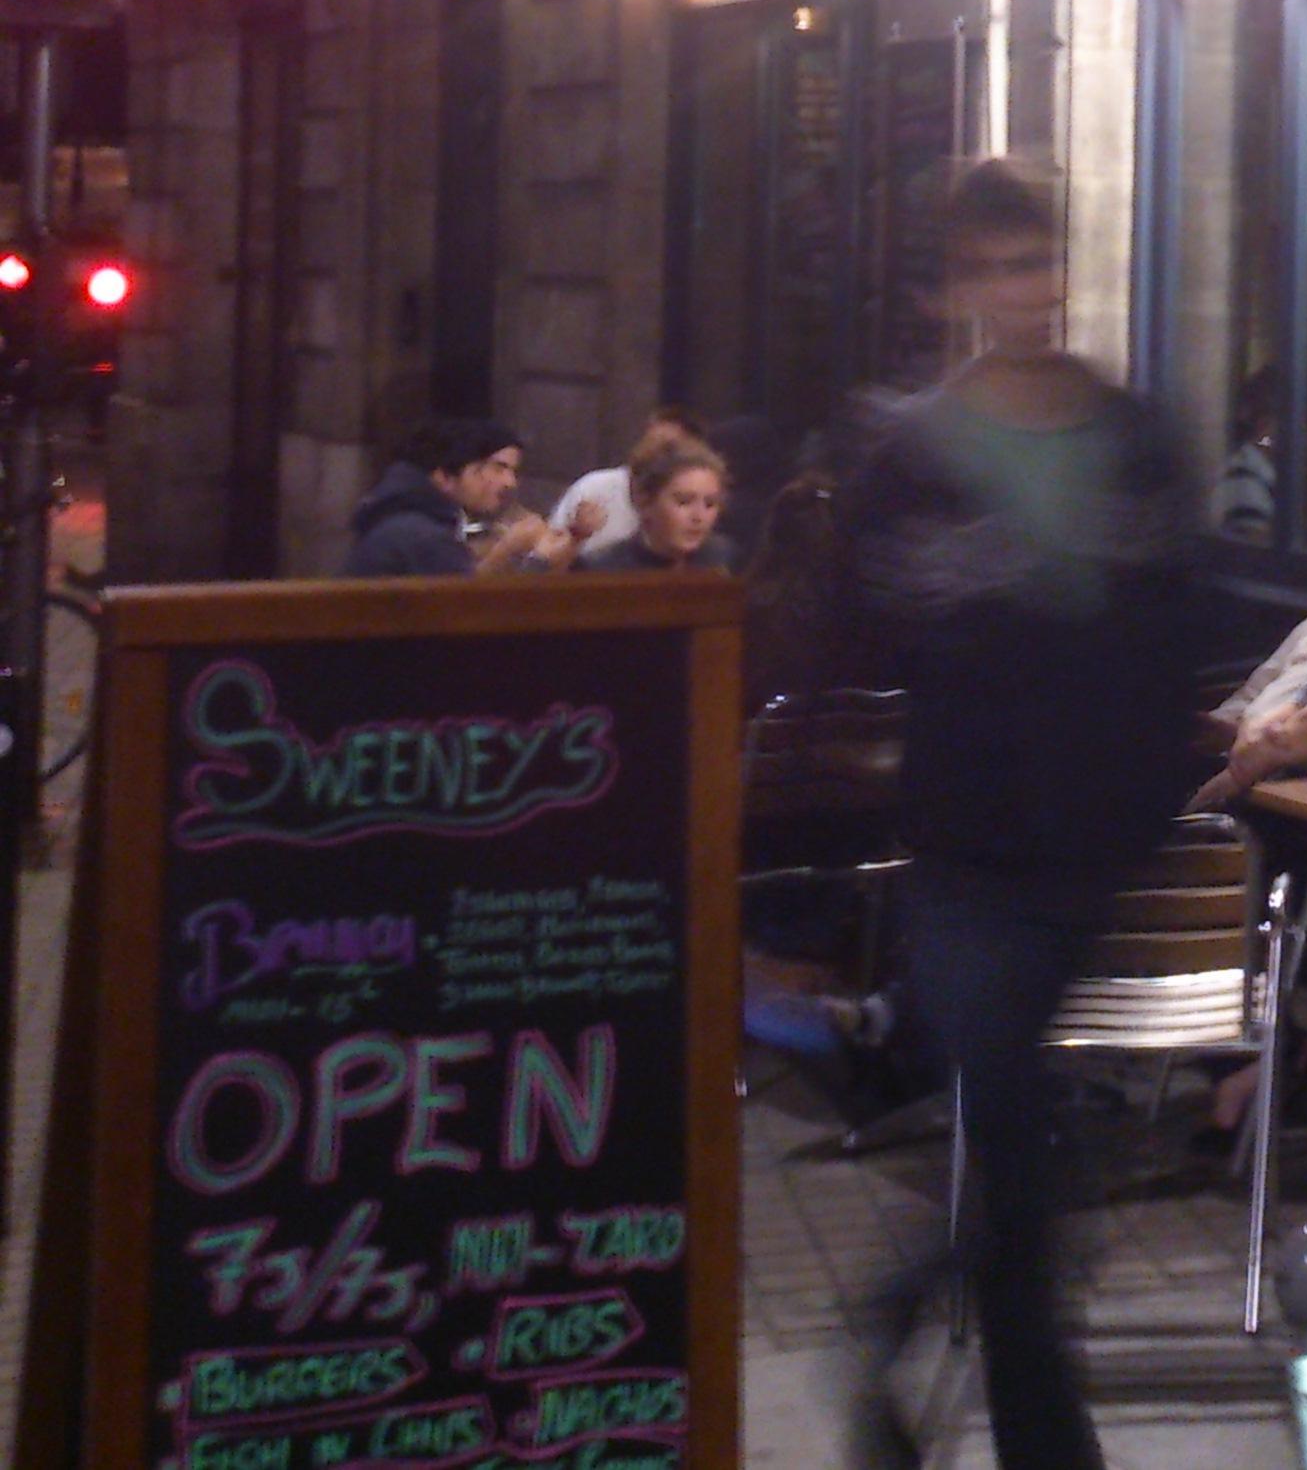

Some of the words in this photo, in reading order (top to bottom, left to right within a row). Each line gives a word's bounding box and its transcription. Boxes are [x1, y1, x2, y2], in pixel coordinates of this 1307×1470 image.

[187, 660, 614, 816] SWEENEY'S
[168, 1025, 618, 1196] OPEN
[496, 1299, 627, 1367] RIBS
